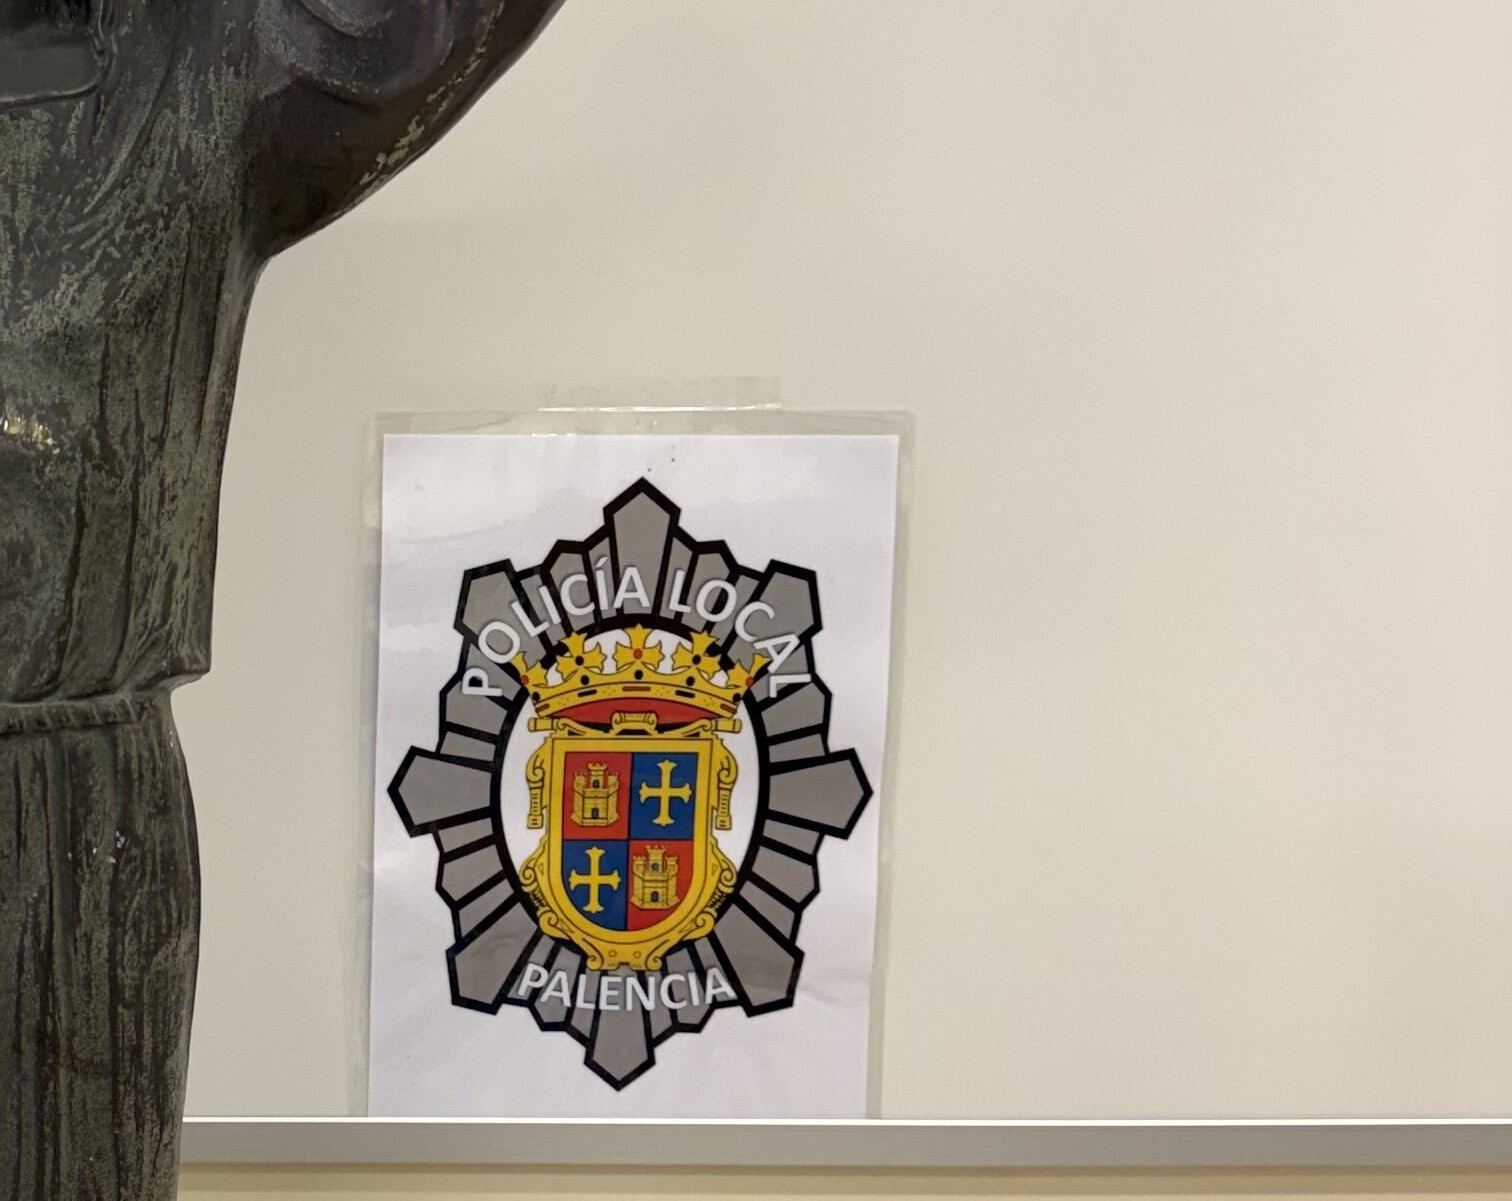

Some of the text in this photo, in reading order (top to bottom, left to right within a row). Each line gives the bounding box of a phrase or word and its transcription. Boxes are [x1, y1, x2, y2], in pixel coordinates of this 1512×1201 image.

[462, 557, 812, 698] POLICÍA LOCAL
[518, 963, 738, 1012] PALENCIA
